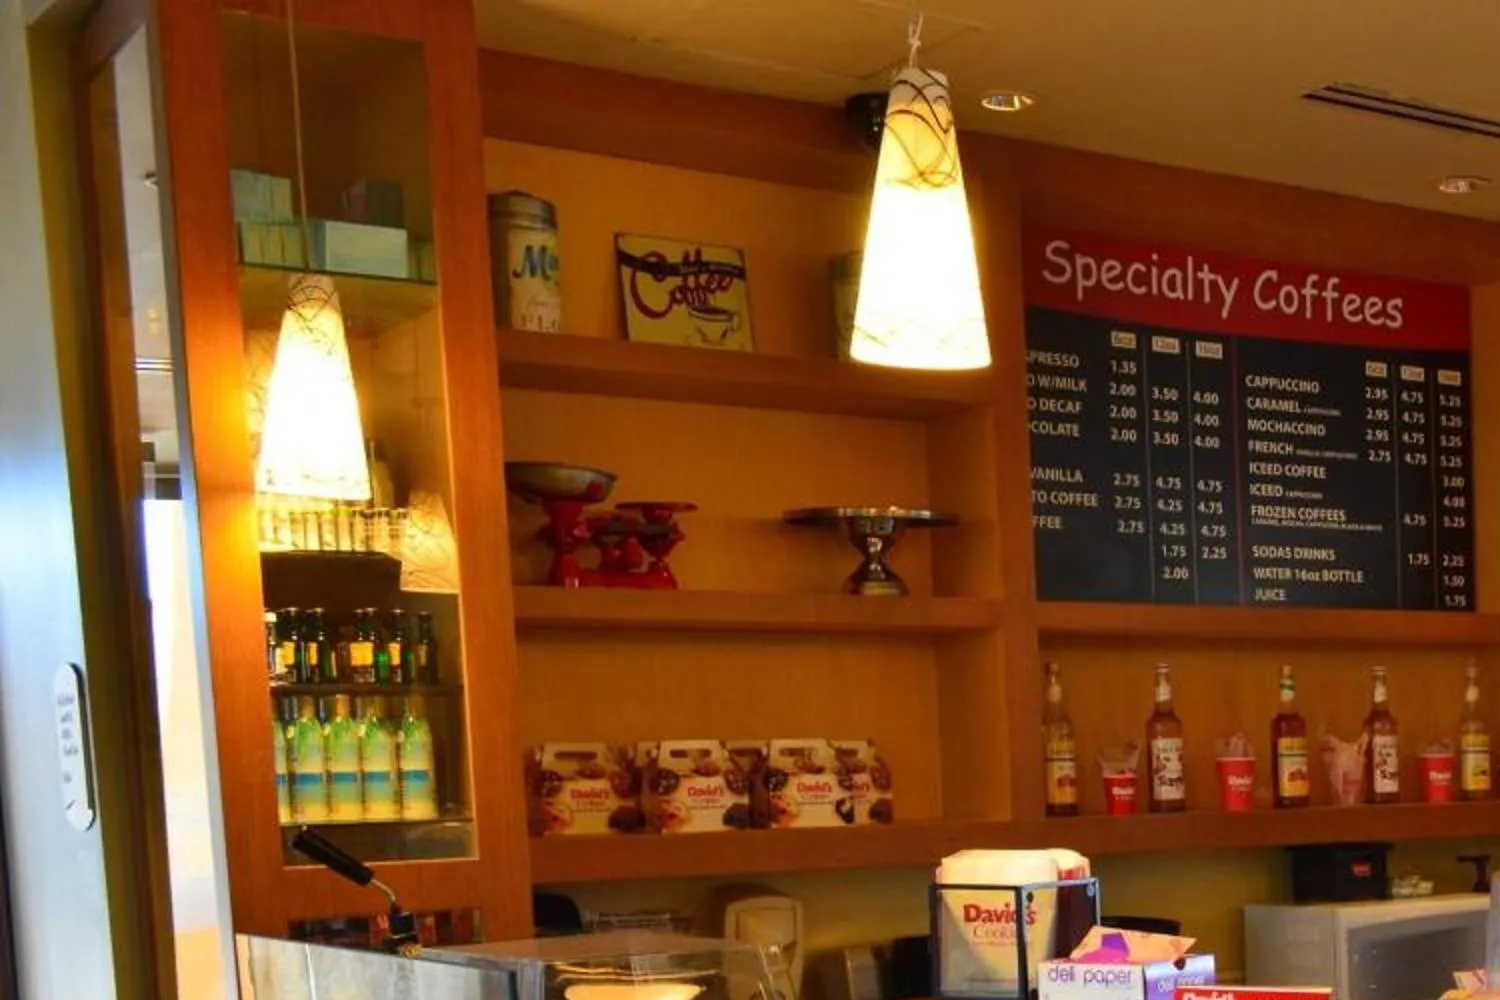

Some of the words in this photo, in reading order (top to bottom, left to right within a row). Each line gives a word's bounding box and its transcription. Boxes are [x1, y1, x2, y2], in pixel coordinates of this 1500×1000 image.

[1042, 240, 1239, 319] Specialty
[1253, 269, 1404, 329] Coffees
[1026, 350, 1079, 369] PRESSO
[1038, 375, 1087, 393] W/MILK
[1109, 382, 1137, 397] 2.00
[1151, 387, 1179, 402] 3.50
[1193, 391, 1220, 406] 4.00
[1245, 374, 1320, 395] CAPPUCCINO
[1040, 399, 1082, 415] DECAF
[1109, 405, 1137, 420] 2.00
[1193, 414, 1220, 429] 4.00
[1246, 397, 1302, 414] CARAMEL
[1029, 420, 1080, 438] COLATE
[1110, 427, 1137, 442] 2.00
[1152, 432, 1179, 446] 3.50
[1193, 435, 1220, 450] 4.00
[1247, 418, 1327, 438] MOCHACCINO
[1248, 439, 1294, 456] FRENCH
[1284, 463, 1328, 480] COFFEE
[1113, 473, 1140, 488] 2.75
[1155, 476, 1182, 491] 4.75
[1196, 479, 1223, 494] 4.75
[1049, 492, 1099, 508] COFFEE
[1114, 495, 1141, 510] 2.75
[1197, 500, 1224, 516] 4.75
[1251, 503, 1296, 519] FROZEN
[1297, 506, 1346, 523] COFFEES
[1116, 519, 1145, 534] 2.75
[1200, 523, 1227, 538] 4.75
[1160, 544, 1187, 559] 1.75
[1201, 545, 1227, 560] 2.25
[1252, 545, 1292, 560] SODAS
[1293, 546, 1337, 562] DRINKS
[1253, 567, 1292, 581] WATER
[1321, 569, 1364, 585] BOTTLE
[1255, 587, 1287, 602] JUICE
[1048, 965, 1076, 983] deli
[1083, 969, 1132, 990] paper
